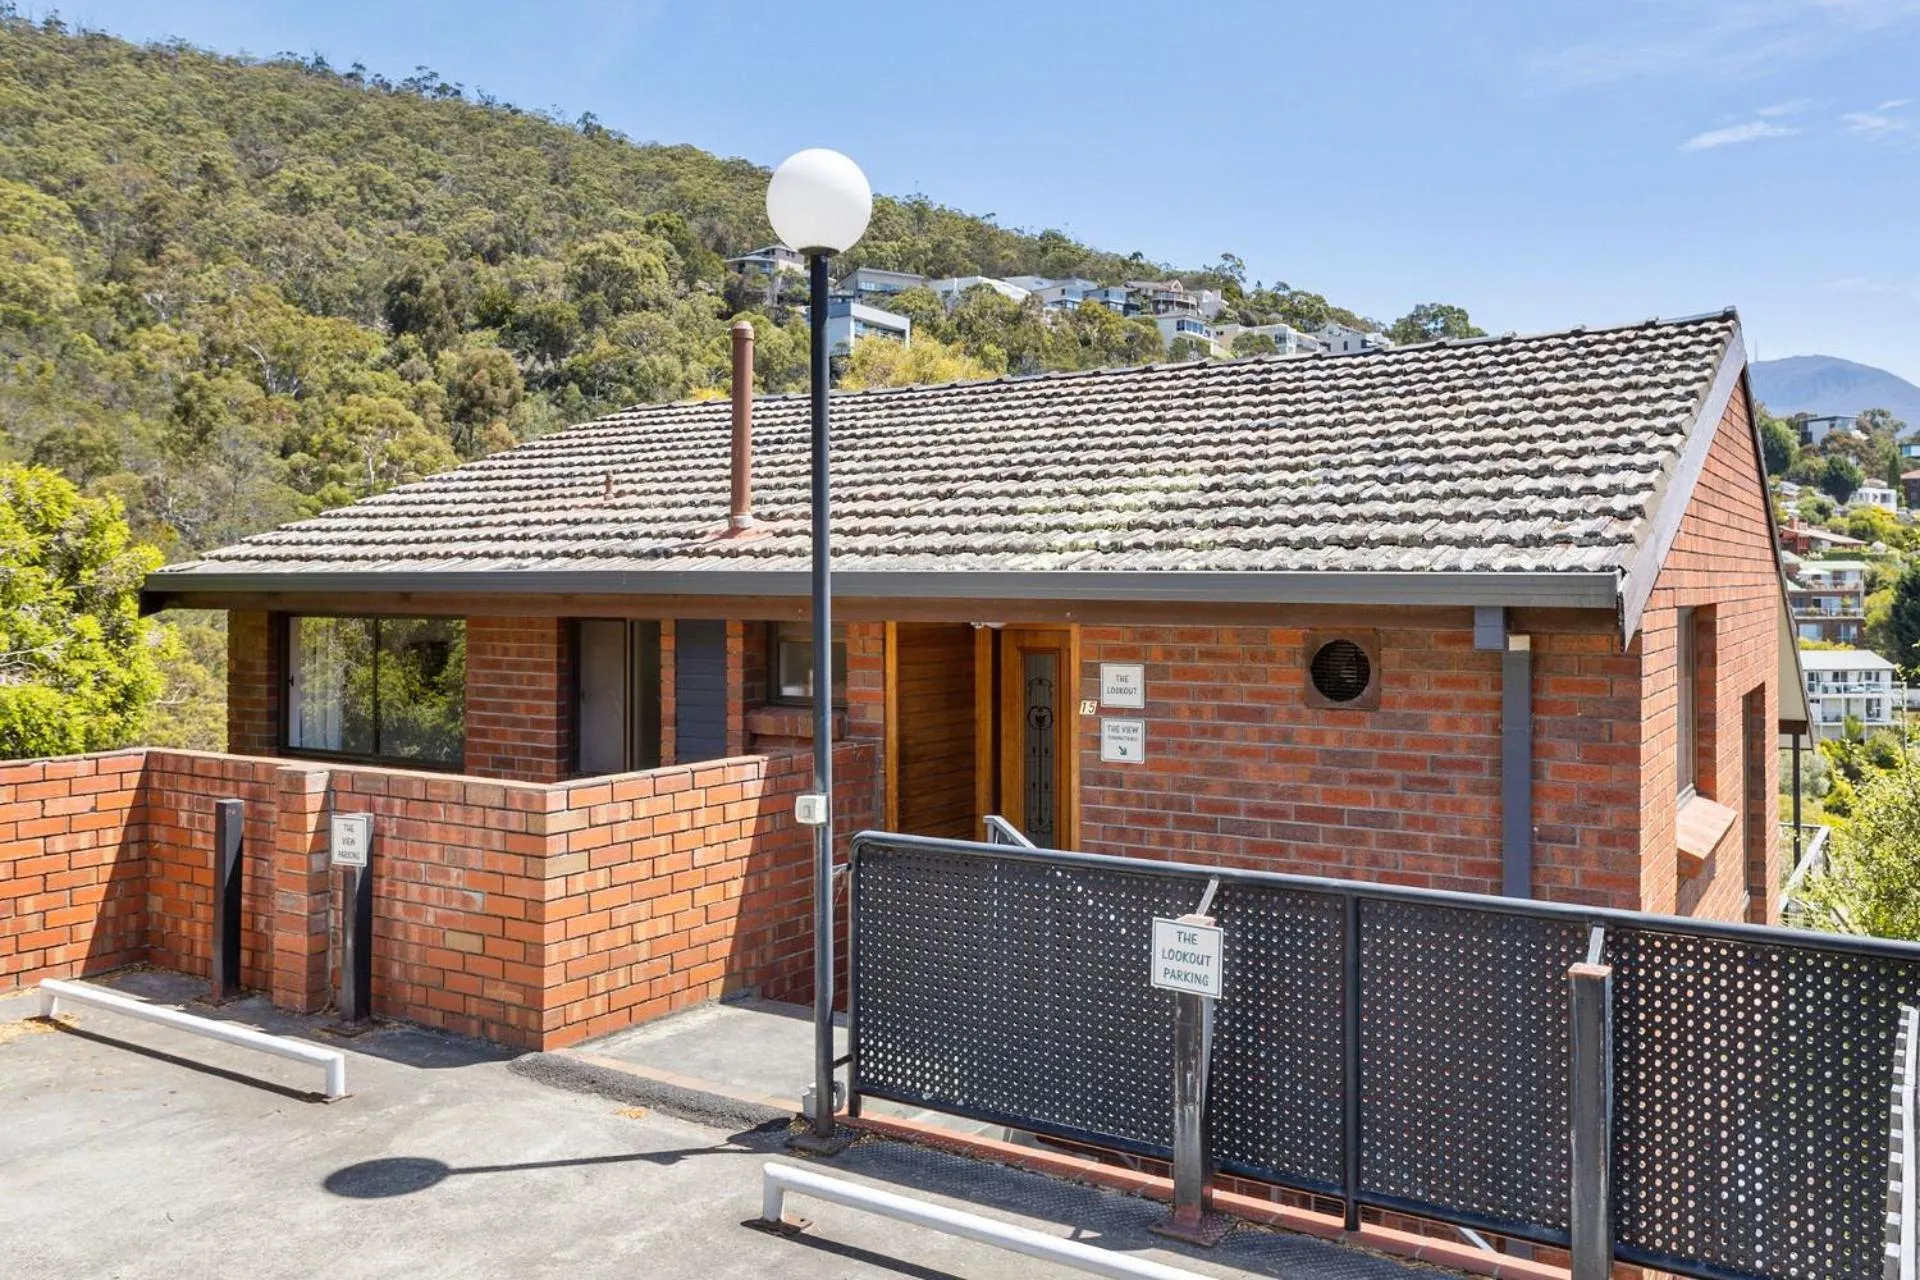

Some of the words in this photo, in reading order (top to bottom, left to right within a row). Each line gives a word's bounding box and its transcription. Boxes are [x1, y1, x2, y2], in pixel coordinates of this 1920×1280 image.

[1116, 674, 1129, 683] THE
[1106, 687, 1137, 695] LOOKOUT
[1081, 702, 1095, 714] 15
[1107, 725, 1120, 733] THE
[1122, 726, 1139, 734] VIEW
[1177, 931, 1199, 945] THE
[1161, 948, 1213, 967] LOOKOUT
[1163, 967, 1209, 987] PARKING
